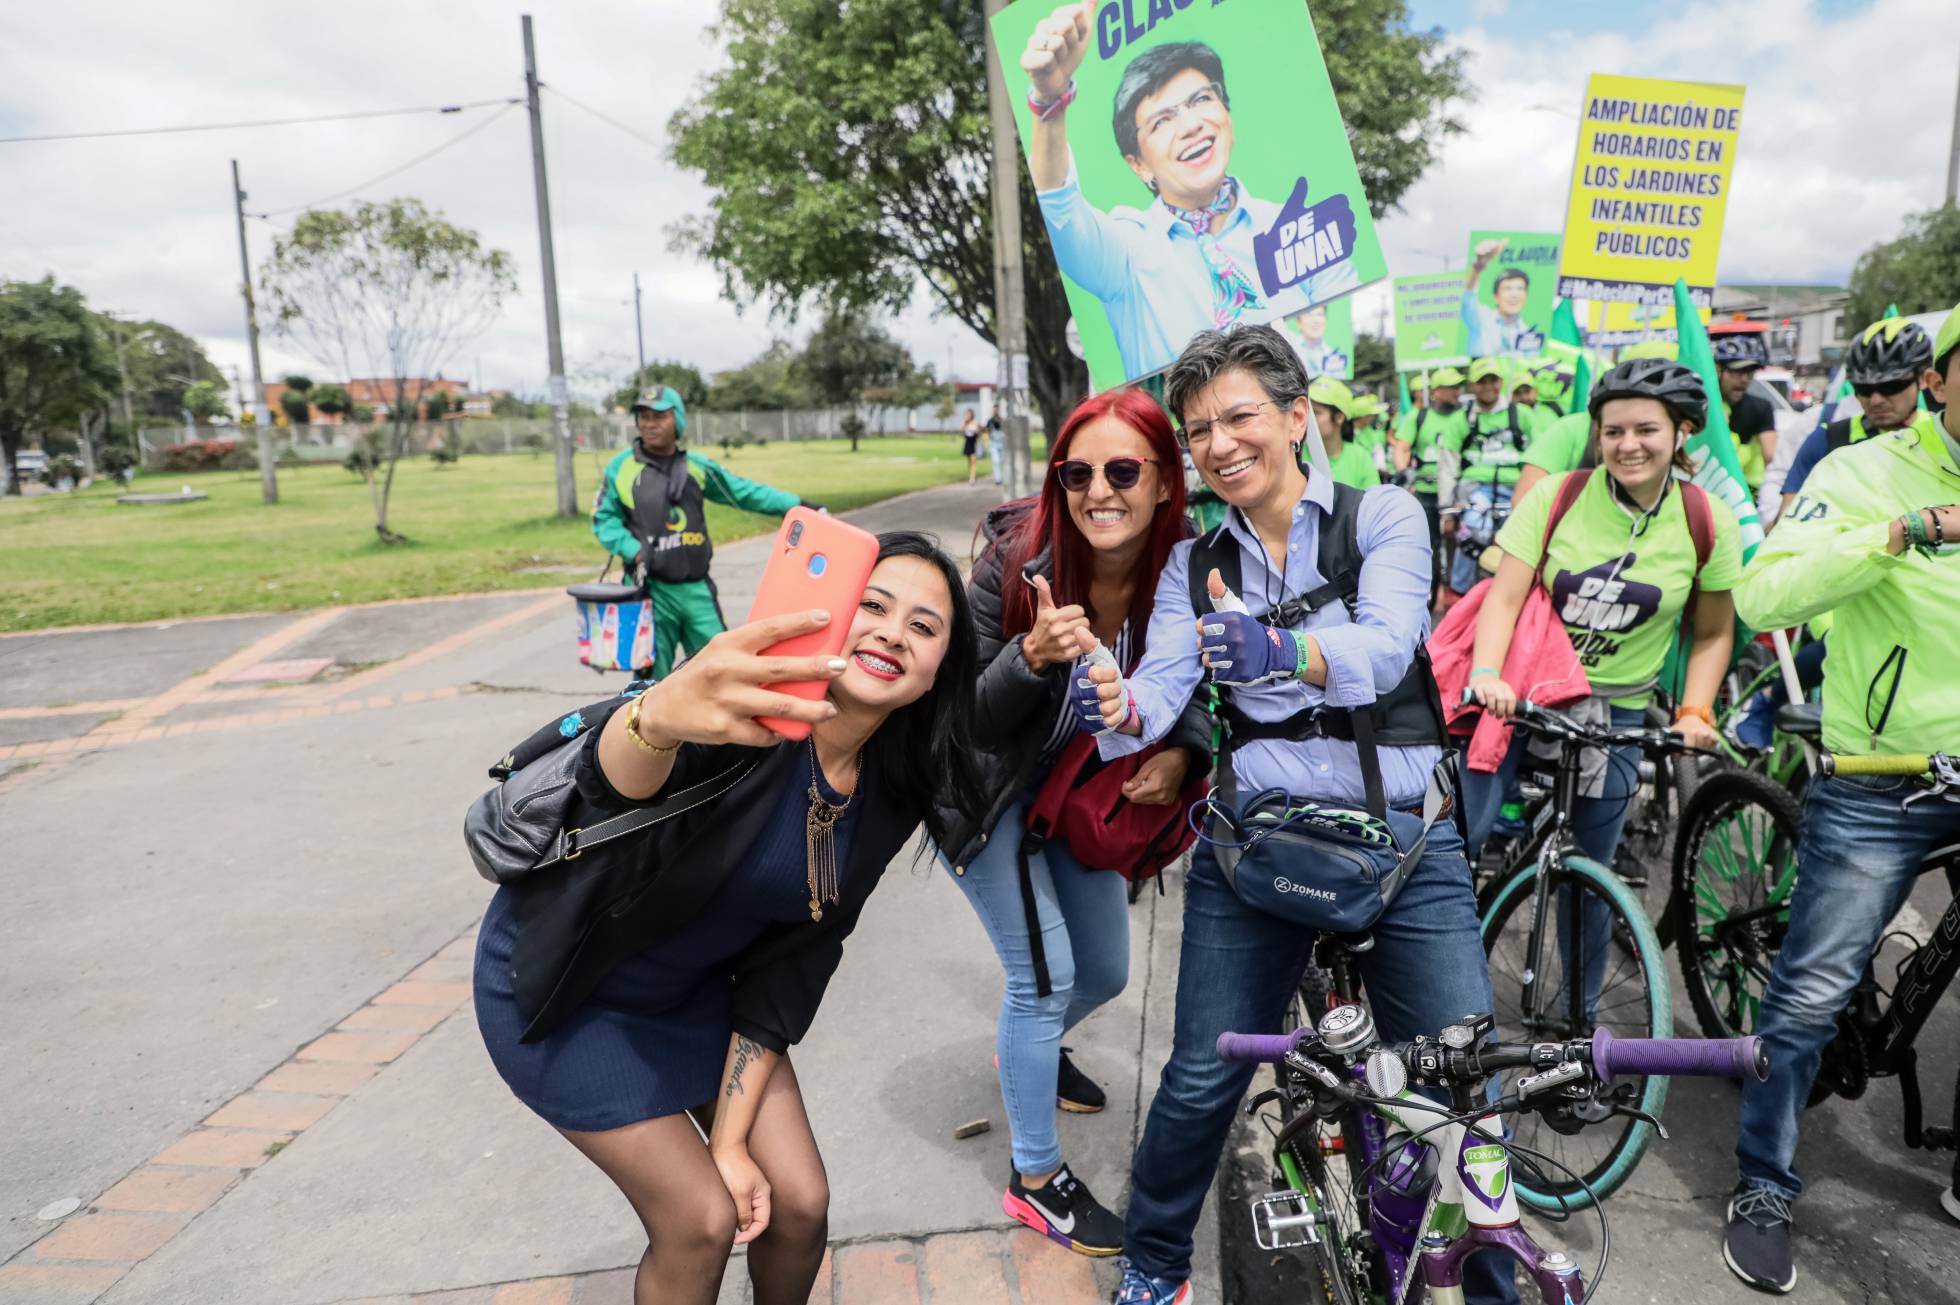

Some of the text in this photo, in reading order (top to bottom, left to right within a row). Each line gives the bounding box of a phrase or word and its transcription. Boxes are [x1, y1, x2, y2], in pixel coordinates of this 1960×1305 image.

[1588, 98, 1739, 130] AMPLIACIÓN DE
[1593, 132, 1723, 162] HORARIOS EN
[1584, 165, 1721, 195] LOS JARDINES
[1592, 198, 1702, 227] INFANTILES
[1280, 210, 1315, 249] DE
[1596, 226, 1691, 258] PÚBLICOS
[1274, 220, 1344, 284] UNA!
[1578, 577, 1626, 603] DE
[1561, 593, 1640, 631] UNA!
[1292, 883, 1337, 900] ZOMAKE
